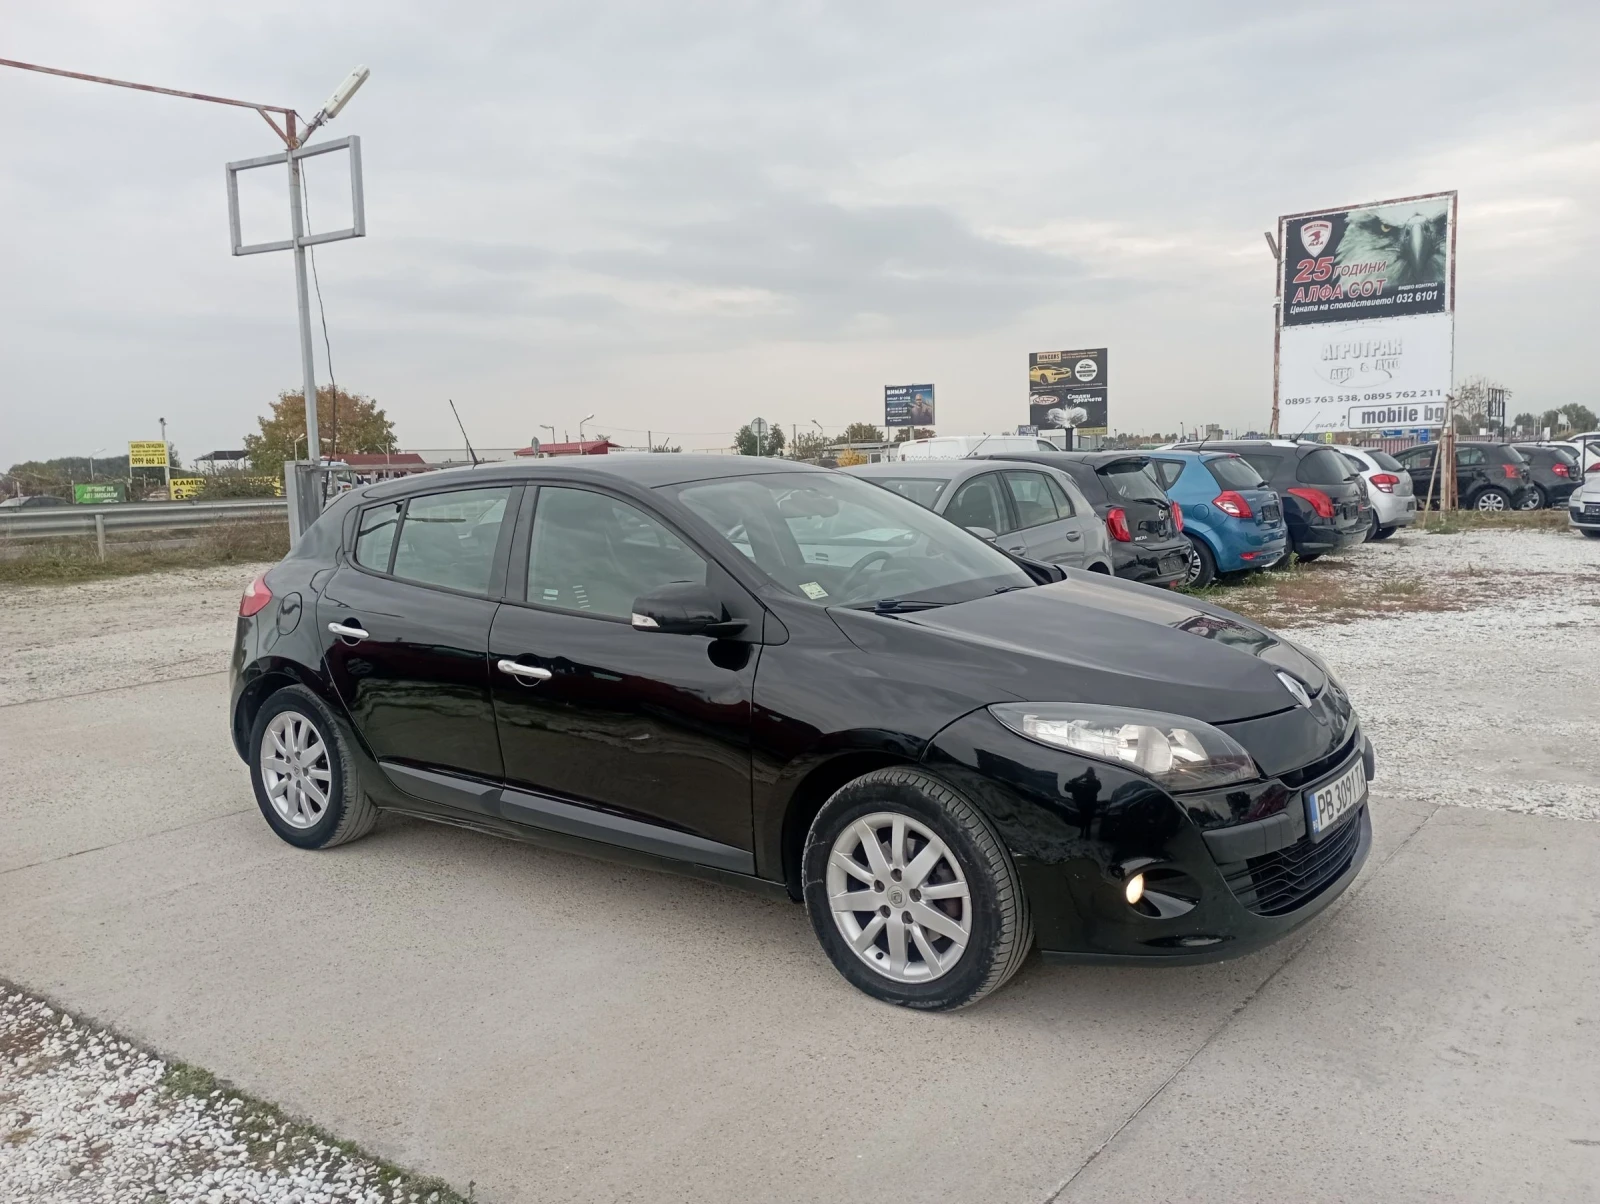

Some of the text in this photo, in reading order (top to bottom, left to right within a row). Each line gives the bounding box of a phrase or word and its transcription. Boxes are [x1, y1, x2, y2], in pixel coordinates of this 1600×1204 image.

[1293, 256, 1387, 283] 25 ГОДИНИ
[1292, 279, 1387, 304] АЛФА СОТ
[1396, 290, 1438, 303] 032 6101
[1290, 304, 1319, 315] Цената
[1329, 296, 1395, 310] спокойствието!
[1285, 397, 1312, 405] 0895
[1337, 394, 1361, 402] 538,
[1364, 392, 1392, 401] 0895
[1396, 390, 1417, 398] 762
[1420, 389, 1441, 397] 211
[1361, 405, 1445, 424] mobile bg
[131, 457, 144, 465] 0999
[145, 457, 155, 465] 666
[1317, 789, 1335, 826] PB
[1335, 770, 1357, 813] 3091
